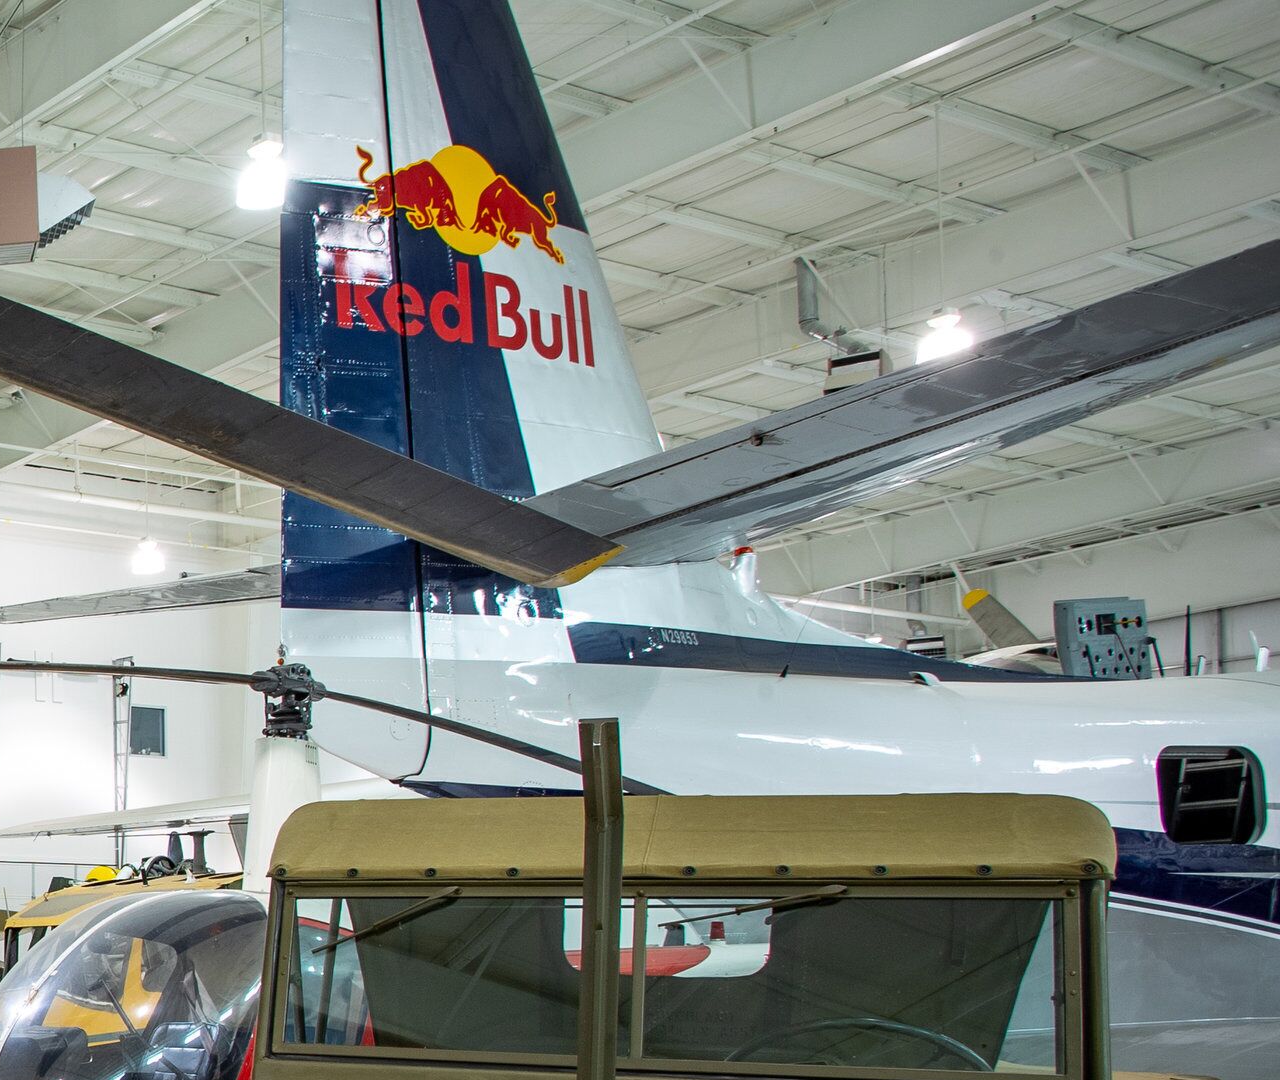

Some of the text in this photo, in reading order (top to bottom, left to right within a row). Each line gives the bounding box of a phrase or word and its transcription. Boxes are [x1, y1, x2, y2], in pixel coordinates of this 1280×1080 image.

[333, 248, 595, 368] Red Bull
[660, 628, 699, 646] N29853
